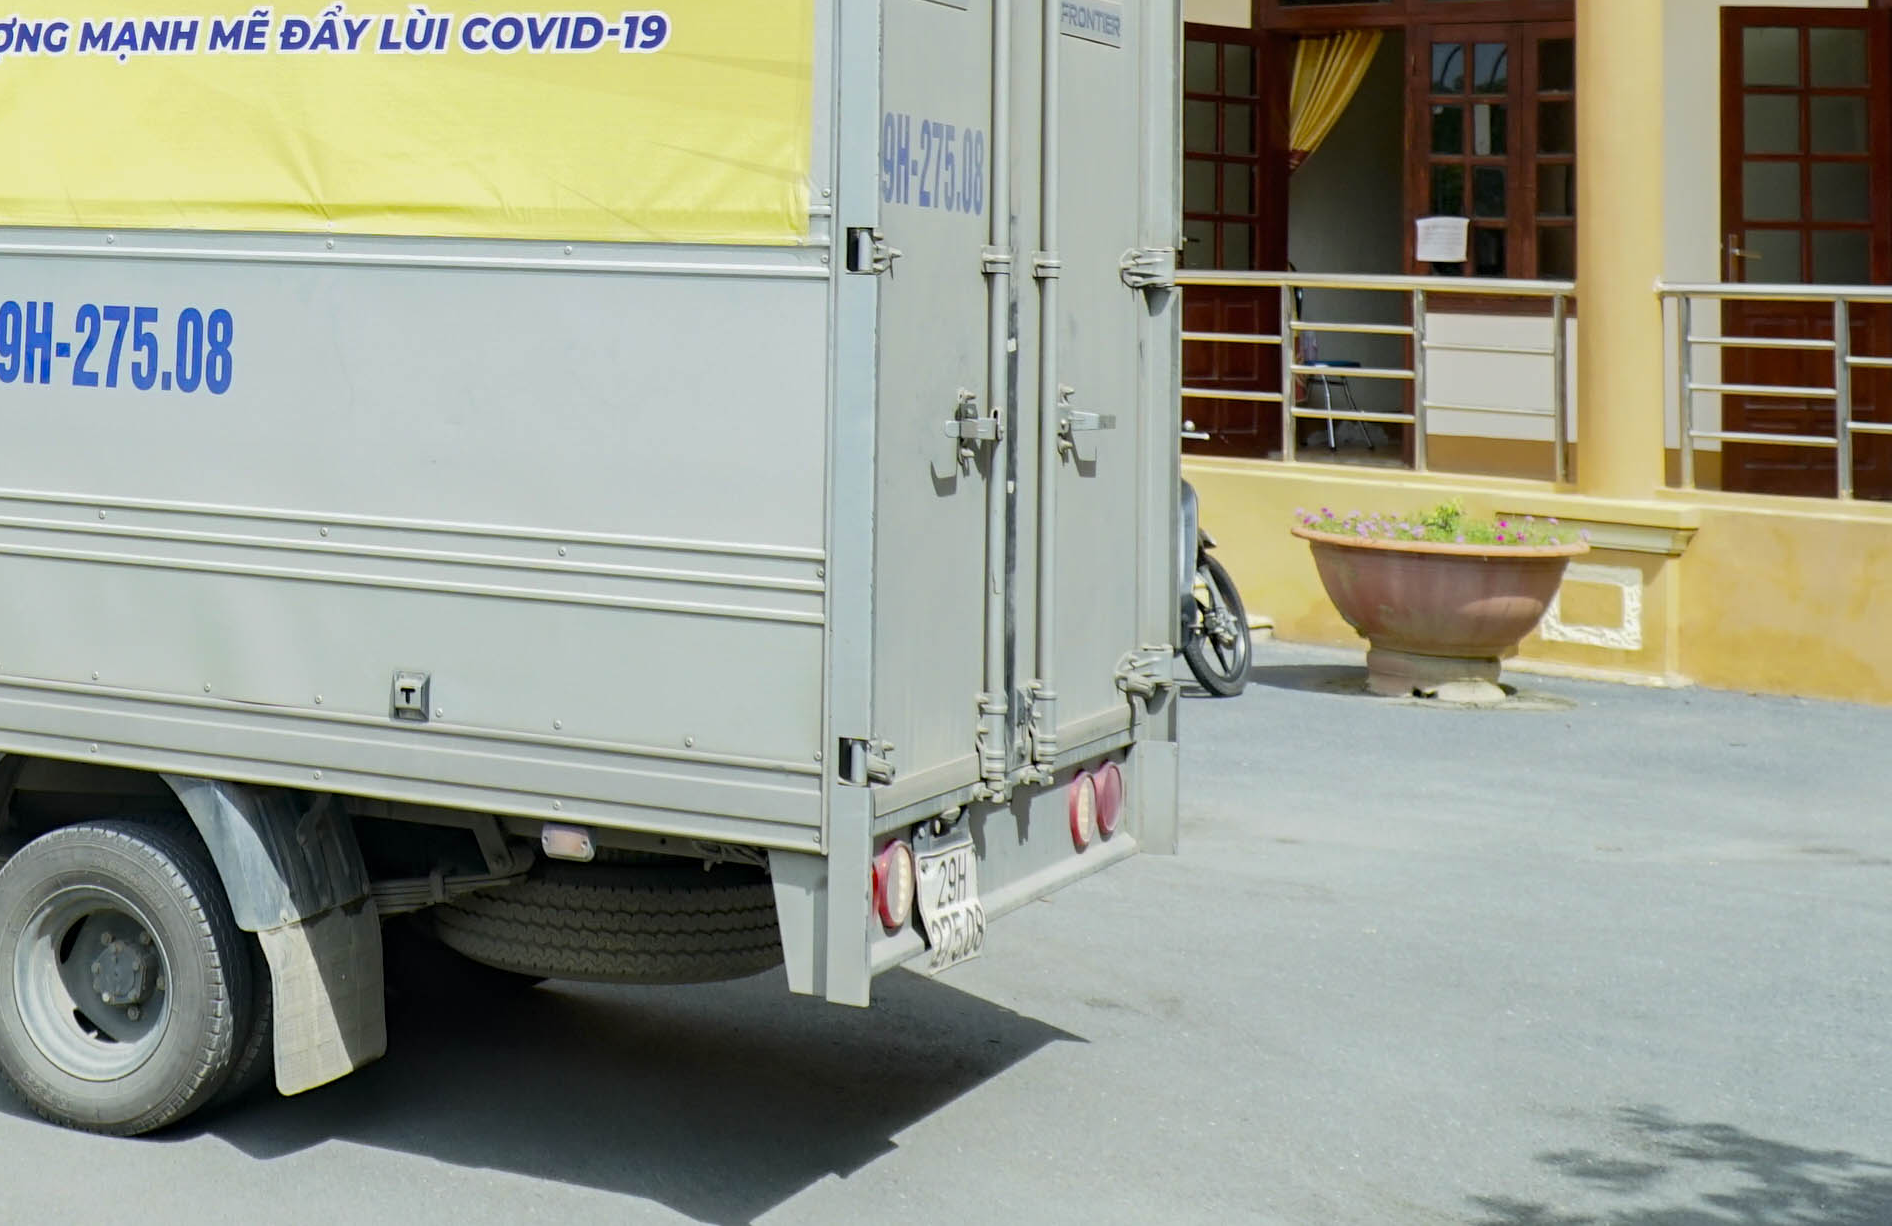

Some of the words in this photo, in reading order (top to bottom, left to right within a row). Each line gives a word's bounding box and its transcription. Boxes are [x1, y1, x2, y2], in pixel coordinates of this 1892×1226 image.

[79, 21, 200, 61] MẠNH
[209, 9, 269, 51] MẼ
[279, 5, 372, 50] ĐẨY
[379, 8, 450, 50] LÙI
[461, 14, 668, 51] COVID-19
[1060, 1, 1121, 38] FRONTIER
[881, 111, 984, 216] 9H-275.08
[937, 852, 967, 910] 29H
